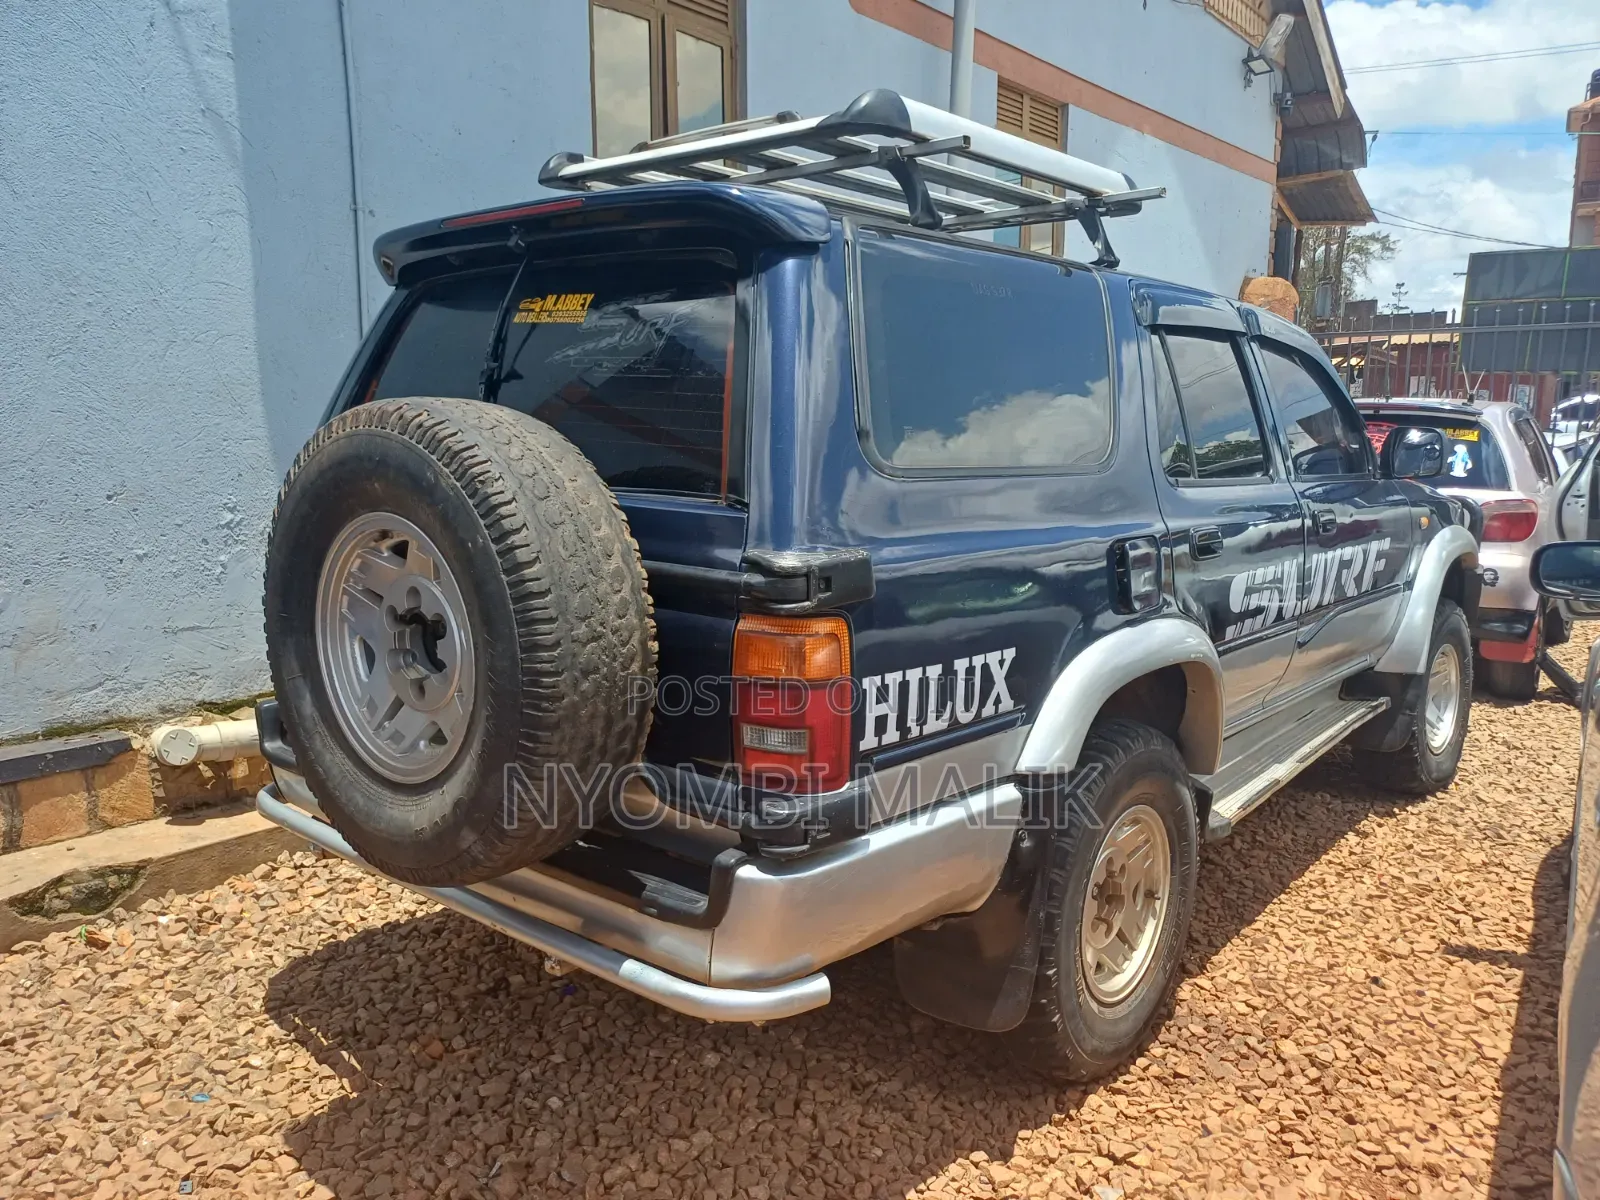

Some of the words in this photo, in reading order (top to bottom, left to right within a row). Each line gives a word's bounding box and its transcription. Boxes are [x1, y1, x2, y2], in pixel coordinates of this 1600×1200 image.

[513, 312, 527, 323] AUTO
[543, 293, 595, 311] M.ABBEY
[1225, 537, 1391, 640] SURF
[859, 646, 1017, 752] HILUX
